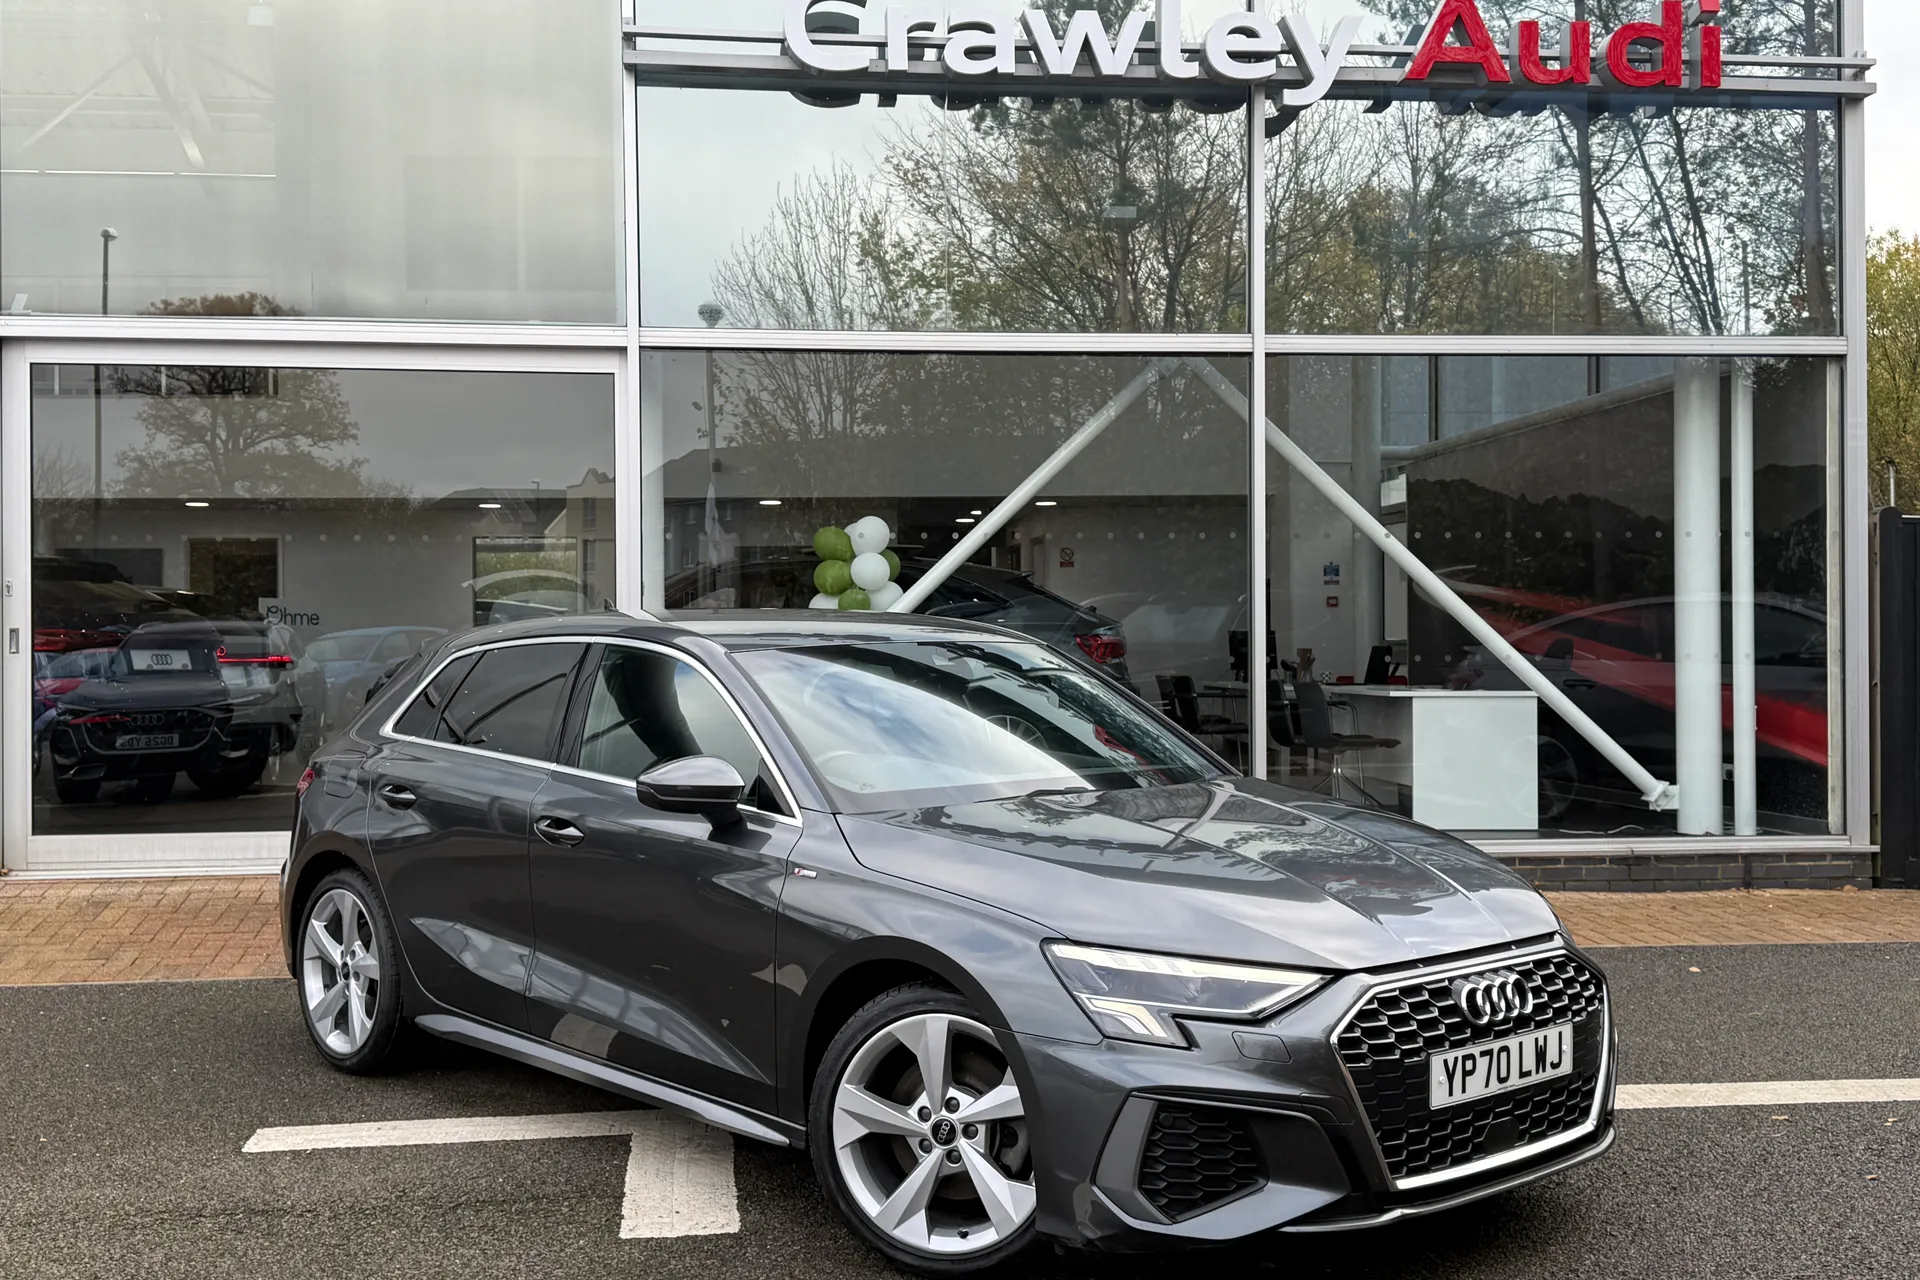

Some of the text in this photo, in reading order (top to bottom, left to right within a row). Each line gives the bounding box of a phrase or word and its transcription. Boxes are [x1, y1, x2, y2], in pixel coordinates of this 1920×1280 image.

[783, 0, 1721, 107] Crawley Audi
[1443, 1031, 1563, 1097] YP70 LWJ
